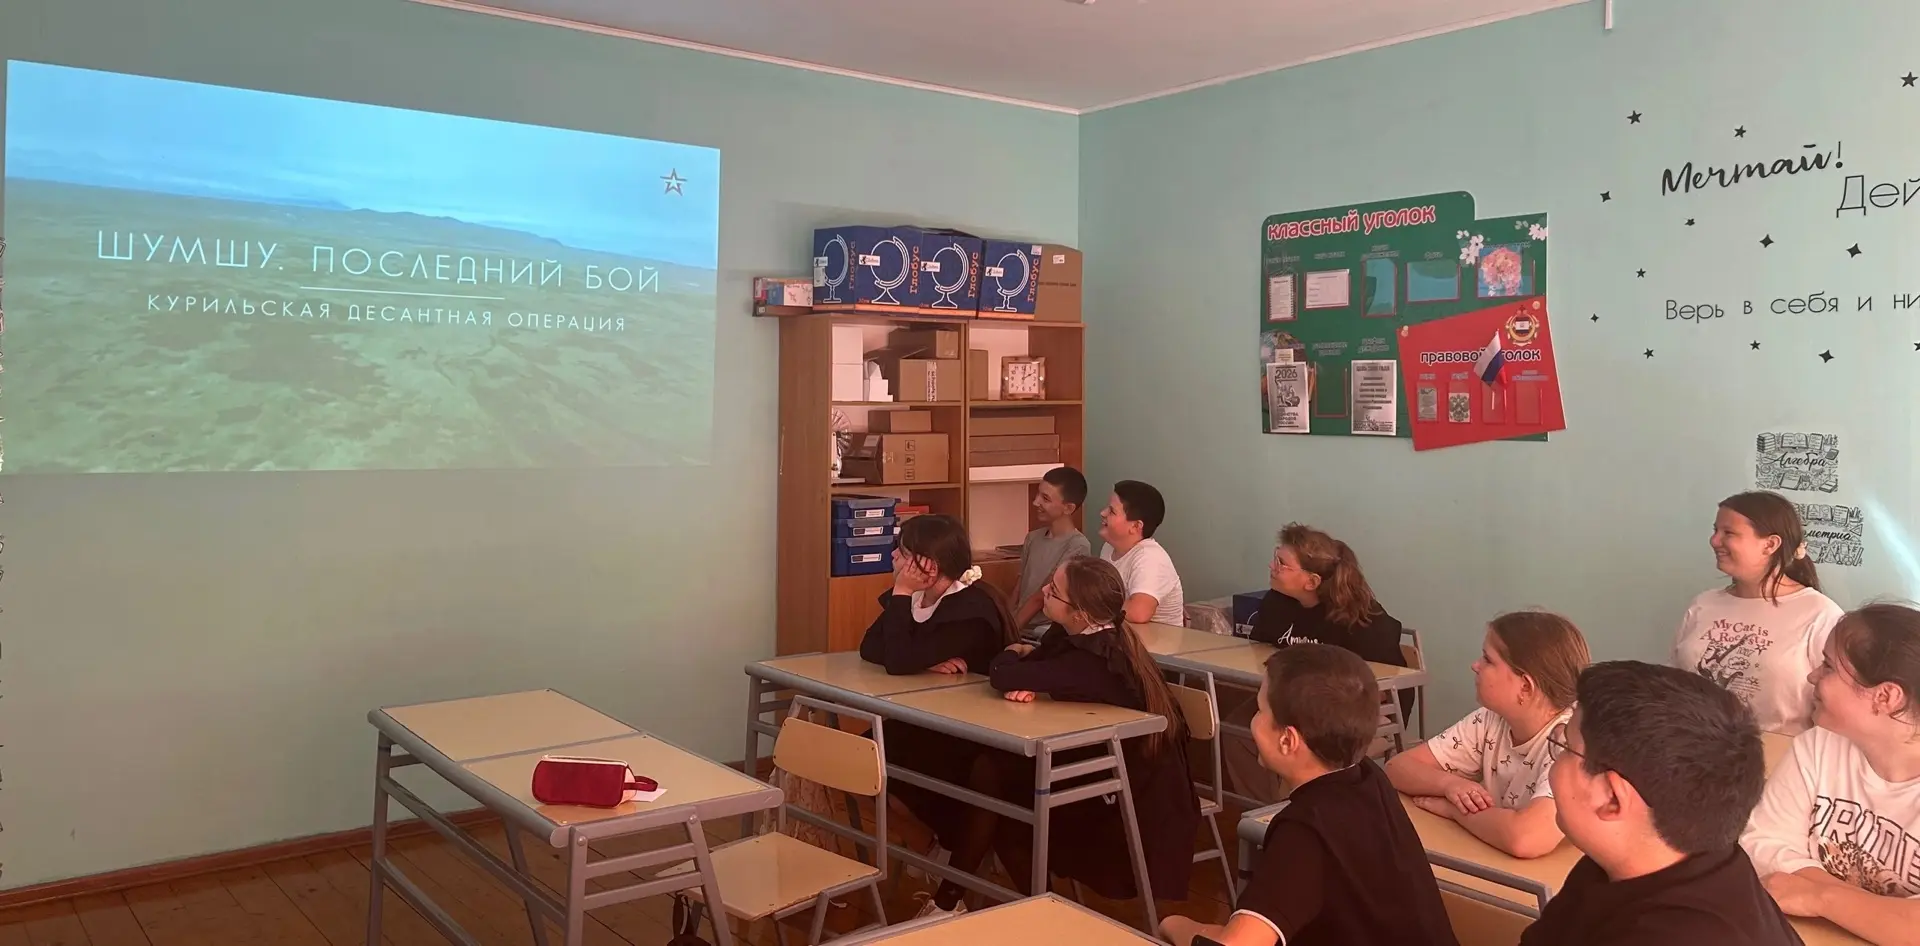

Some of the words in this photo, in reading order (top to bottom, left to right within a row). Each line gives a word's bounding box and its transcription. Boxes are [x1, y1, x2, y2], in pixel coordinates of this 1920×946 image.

[1662, 141, 1843, 196] Мечтай!
[1267, 209, 1360, 241] классный
[1363, 205, 1436, 235] уголок
[98, 230, 284, 271] ШУМШУ.
[312, 245, 563, 287] ПОСЛЕДНИЙ
[585, 265, 659, 293] БОЙ
[909, 246, 919, 294] Глобус
[967, 252, 979, 298] Глобус
[1027, 258, 1039, 302] Глобус
[147, 294, 330, 318] КУРИЛЬСКАЯ
[348, 304, 492, 326] ДЕСАНТНАЯ
[507, 312, 625, 332] ОПЕРАЦИЯ
[1666, 300, 1724, 324] Верь
[1743, 300, 1753, 315] в
[1770, 291, 1838, 314] себя
[1858, 296, 1872, 311] и
[1275, 368, 1298, 379] 2026
[1501, 349, 1542, 363] олок
[1763, 452, 1827, 471] Алгебра
[1700, 629, 1713, 641] A
[1719, 632, 1774, 647] Rocstar
[1712, 619, 1733, 631] My
[1733, 622, 1755, 633] Cat
[1758, 627, 1769, 636] is
